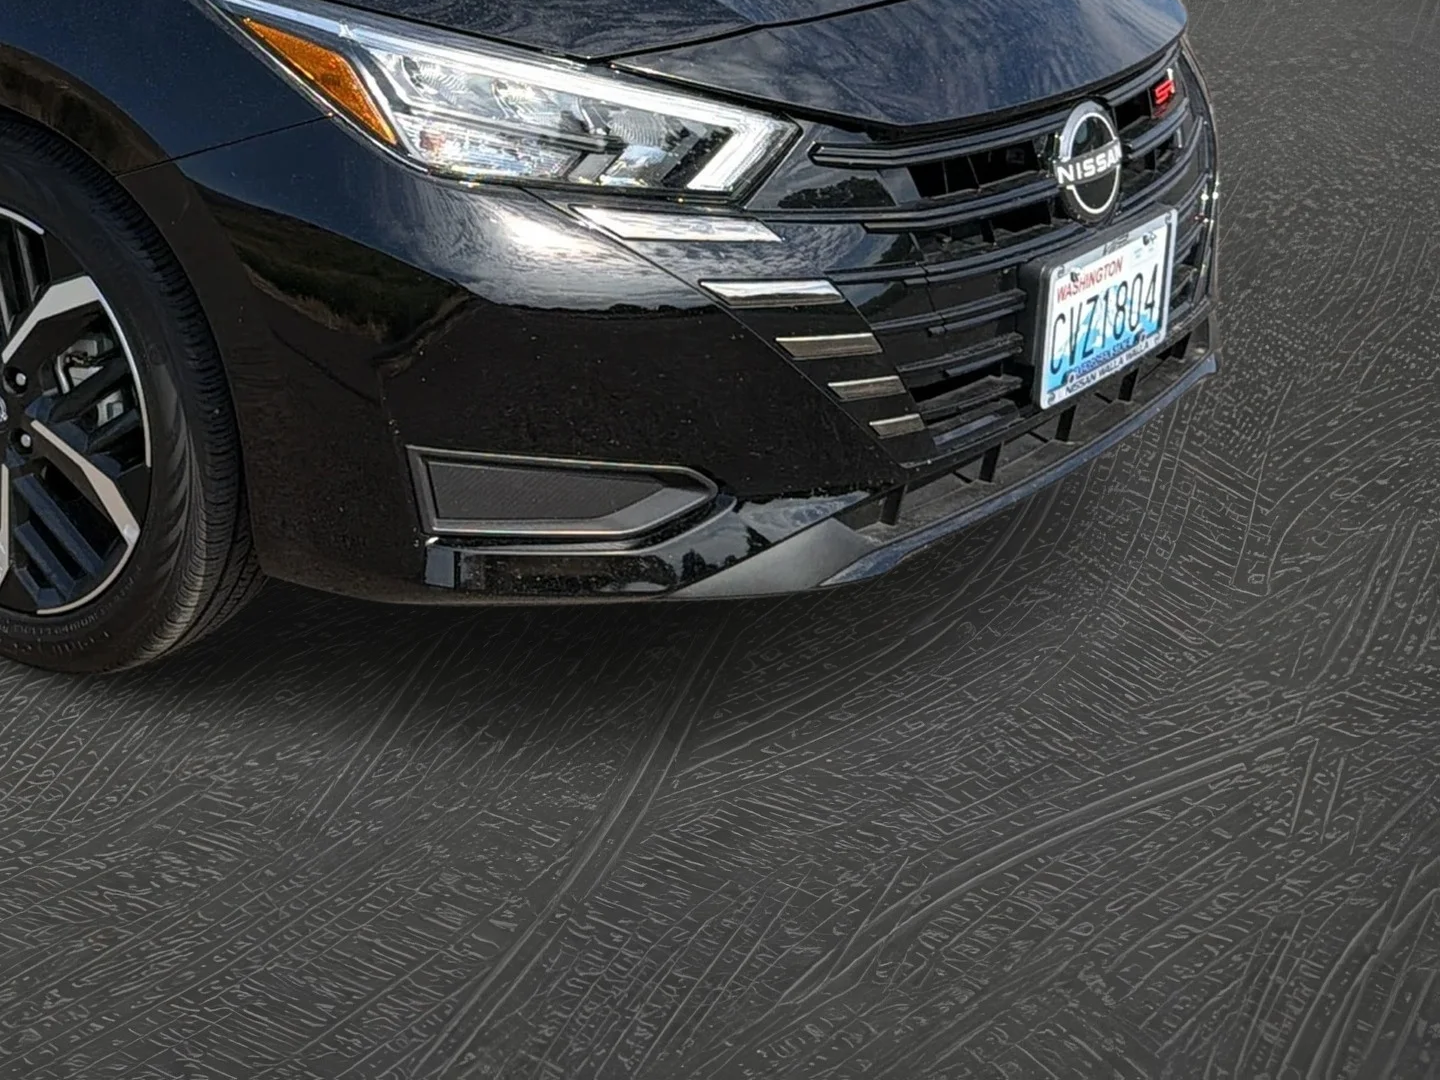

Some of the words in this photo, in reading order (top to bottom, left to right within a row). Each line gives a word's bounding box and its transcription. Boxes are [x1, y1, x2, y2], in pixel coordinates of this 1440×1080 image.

[1057, 142, 1122, 184] NISSAN
[1057, 256, 1123, 302] WASHINGTON
[1050, 264, 1158, 375] CVZ1804
[1065, 372, 1097, 395] NISSAN
